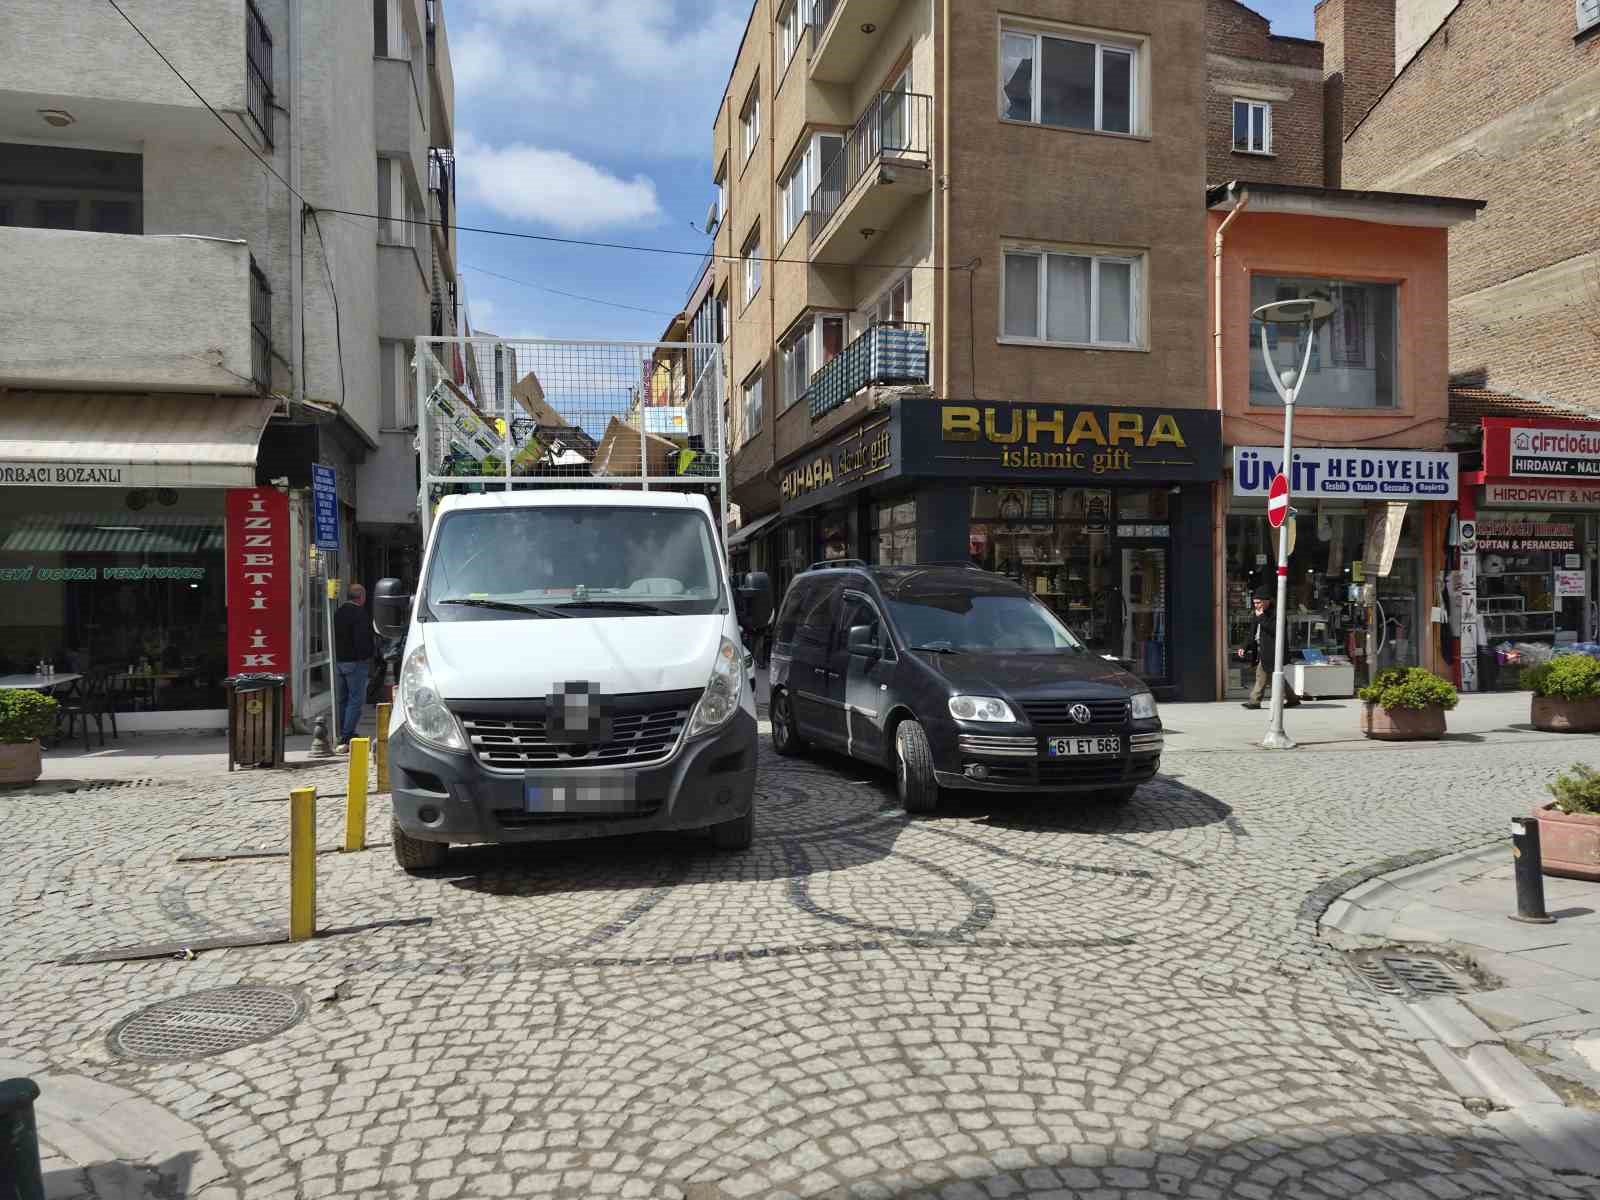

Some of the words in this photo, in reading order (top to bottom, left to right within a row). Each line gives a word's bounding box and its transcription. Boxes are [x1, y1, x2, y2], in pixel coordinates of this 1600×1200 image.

[941, 406, 1187, 448] BUHARA
[782, 456, 833, 497] BUHARA
[871, 428, 890, 469] gift
[1000, 446, 1085, 469] islamic
[1092, 448, 1132, 474] gift
[1515, 459, 1568, 473] HIRDAVAT
[56, 467, 121, 483] BOZANLI
[1494, 488, 1565, 501] HIRDAVAT
[1057, 740, 1071, 754] 61
[1077, 739, 1093, 753] ET
